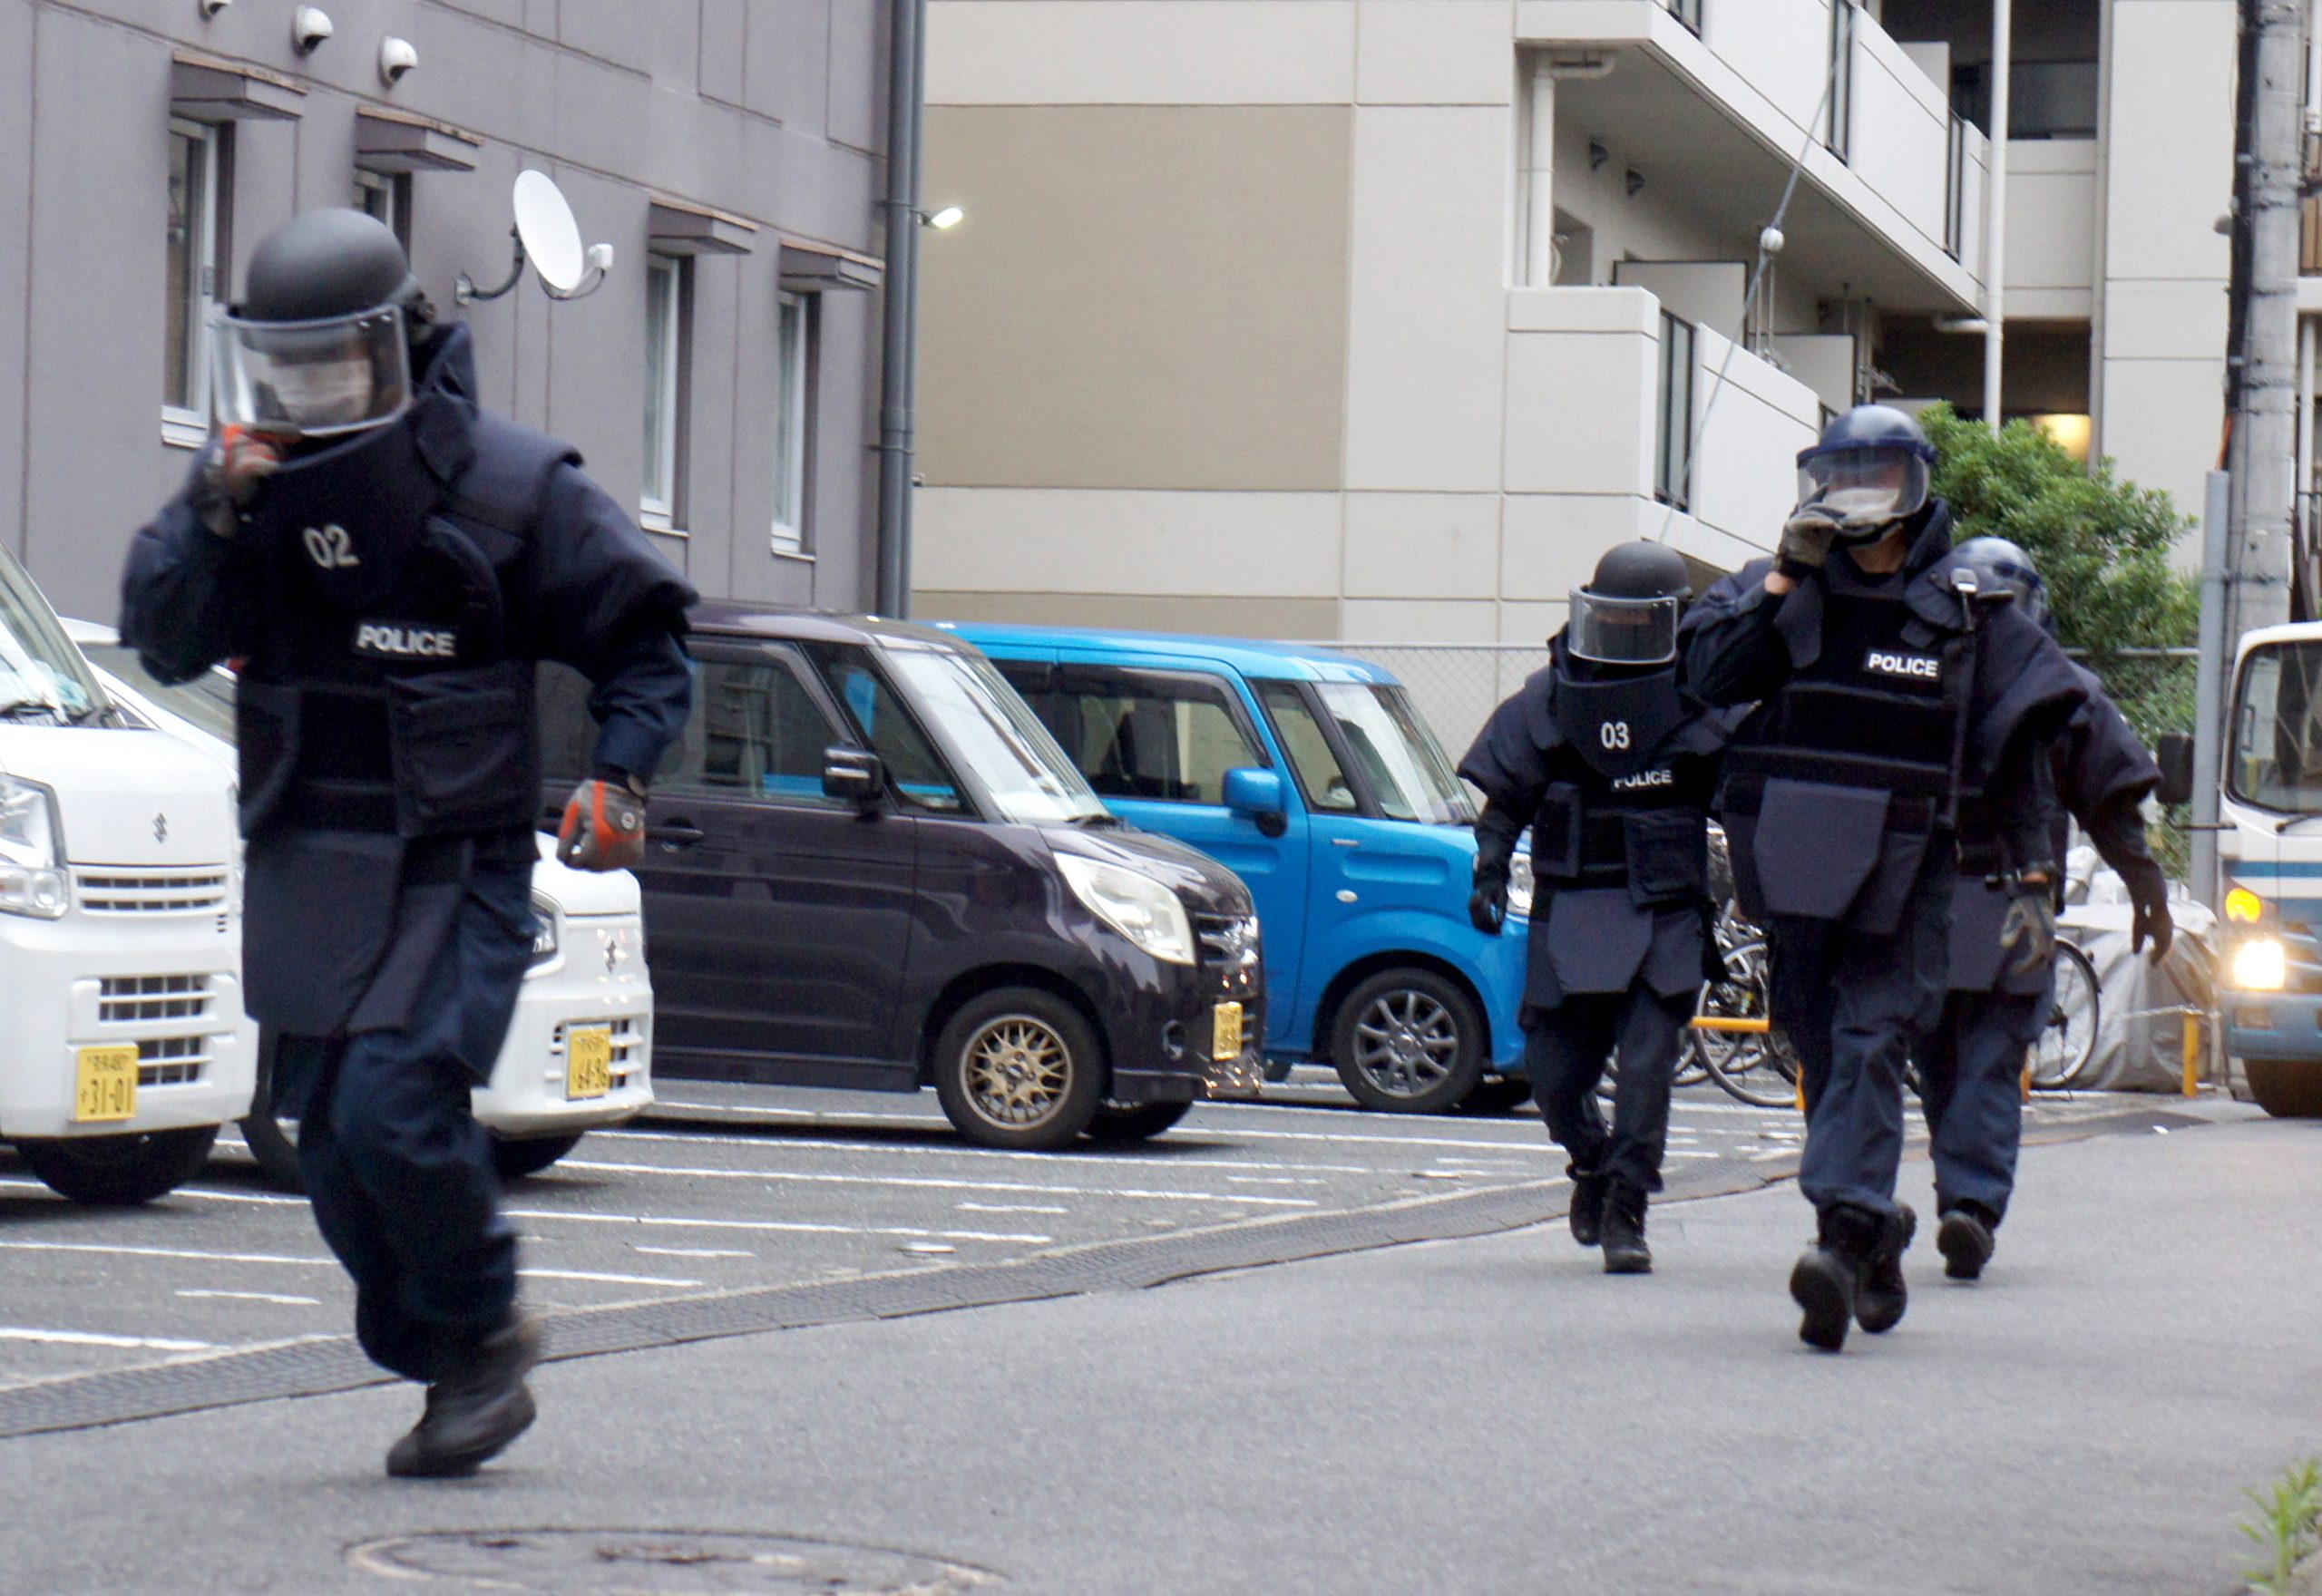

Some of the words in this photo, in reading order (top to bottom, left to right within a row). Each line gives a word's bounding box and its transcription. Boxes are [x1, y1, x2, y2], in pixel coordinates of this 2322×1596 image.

[303, 523, 361, 569] 02
[356, 624, 455, 656] POLICE
[1868, 653, 1938, 676] POLICE
[1601, 721, 1630, 750] 03
